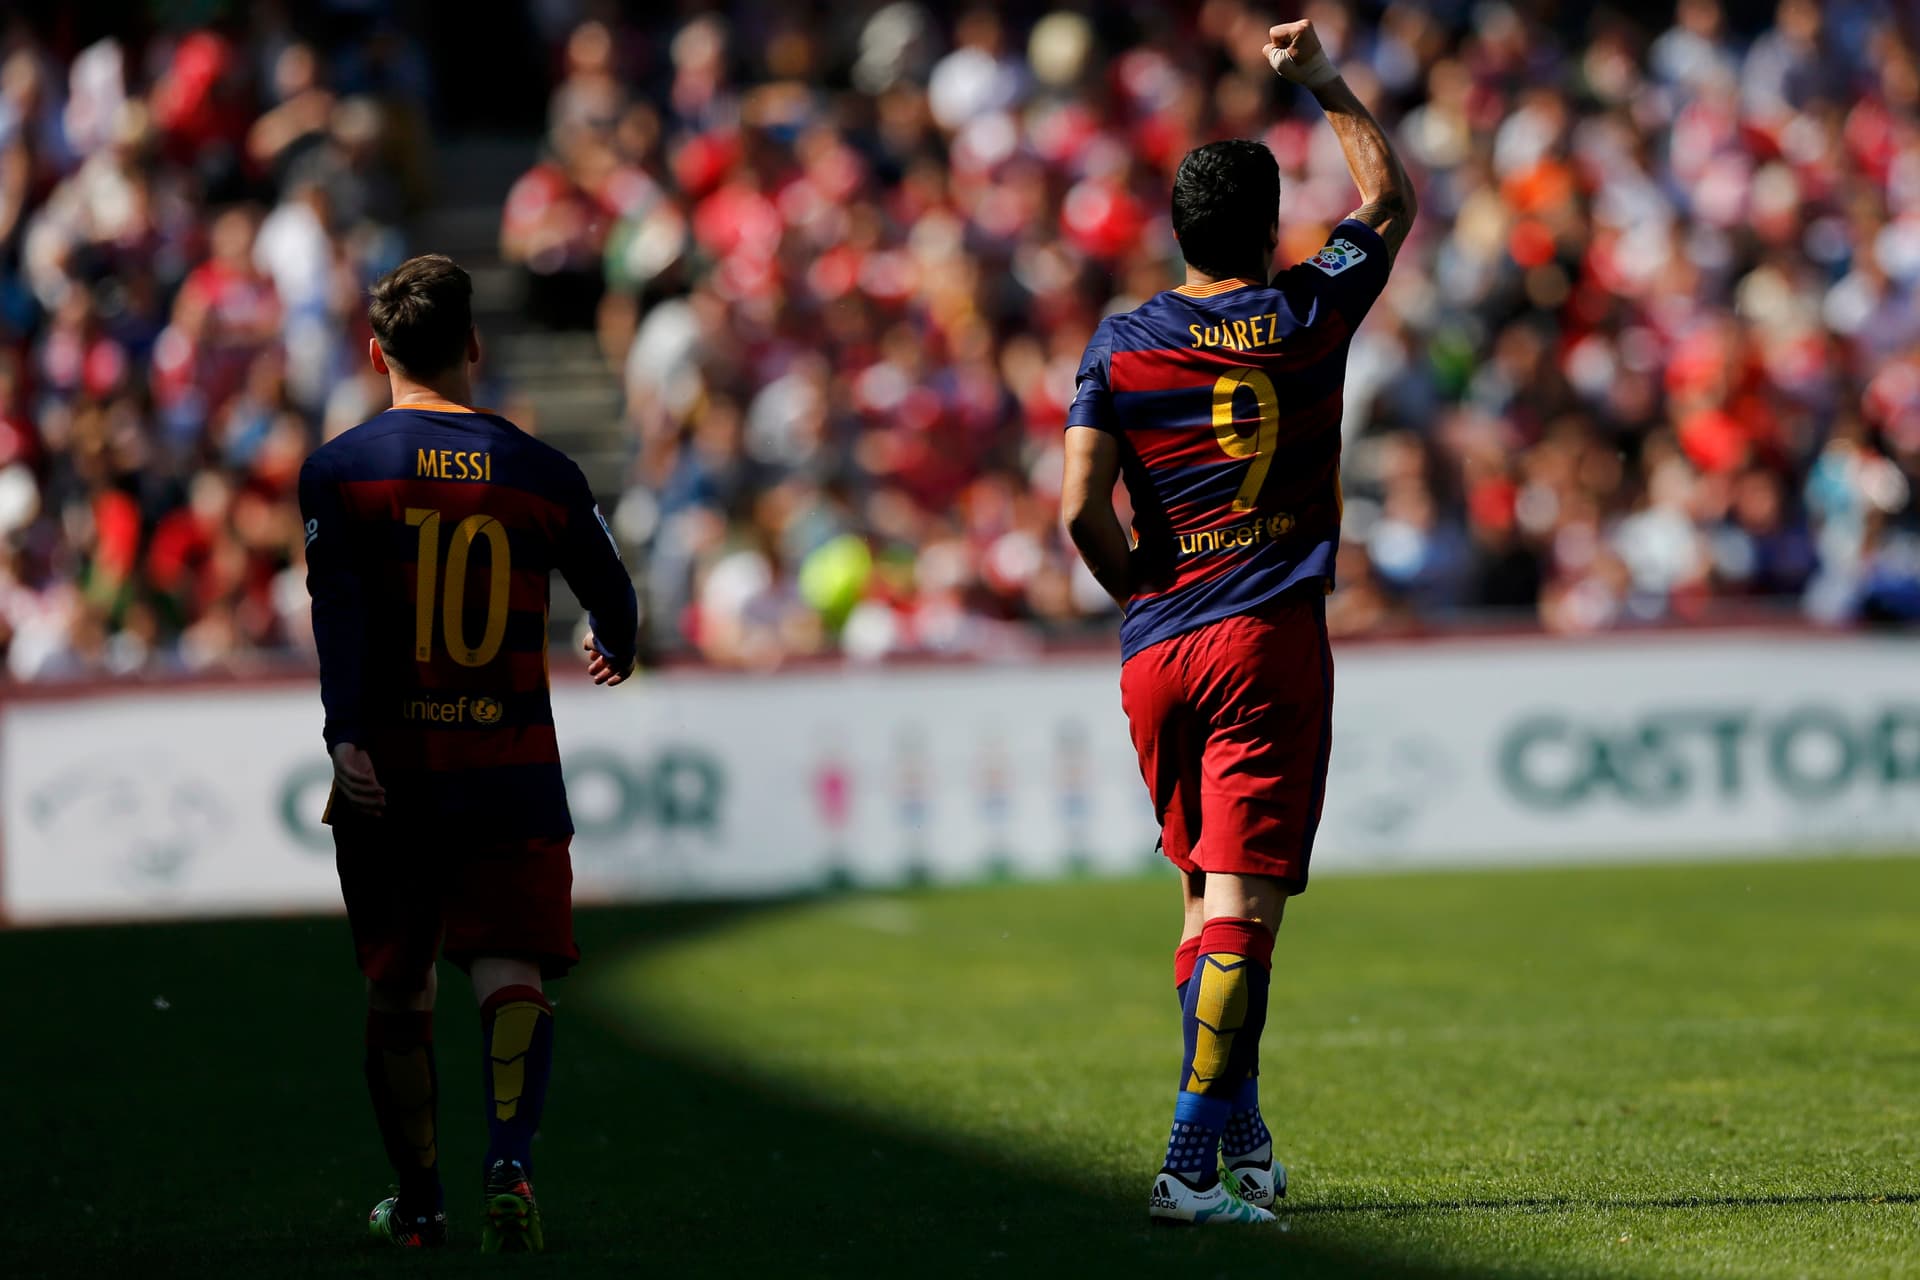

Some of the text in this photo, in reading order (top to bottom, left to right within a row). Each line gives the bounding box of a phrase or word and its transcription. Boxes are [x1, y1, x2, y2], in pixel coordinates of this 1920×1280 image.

[1188, 312, 1283, 351] SUÁREZ
[1212, 367, 1279, 512] 9
[416, 448, 491, 481] MESSI
[1179, 517, 1264, 554] unicef
[405, 507, 511, 668] 10
